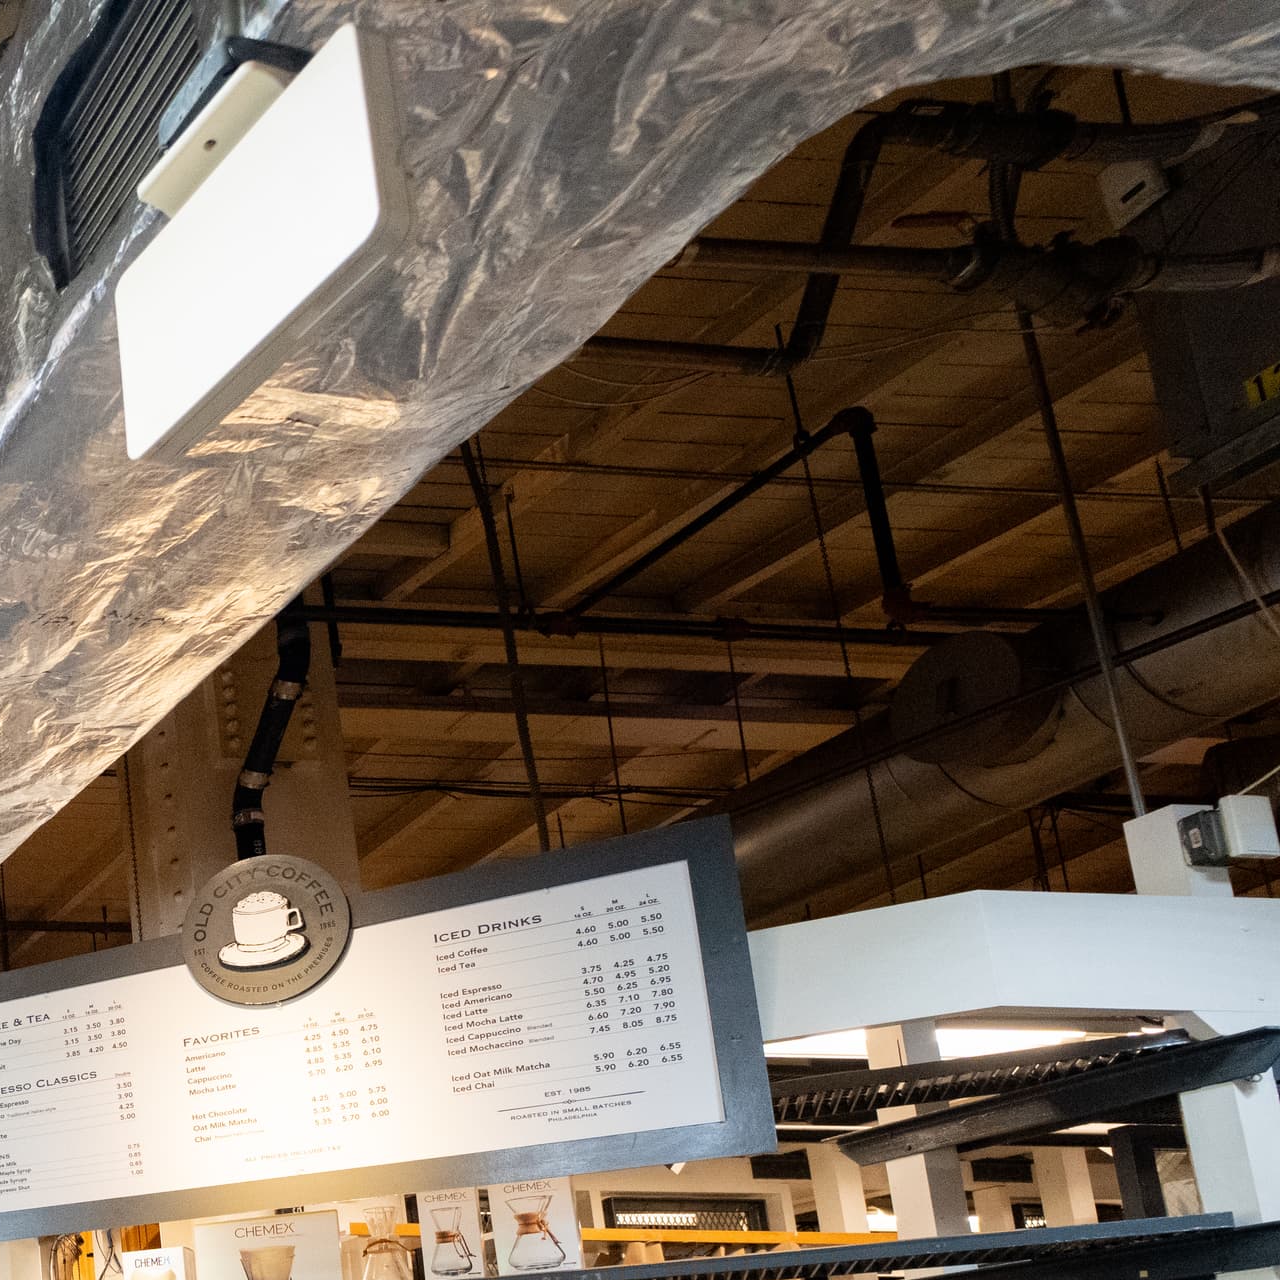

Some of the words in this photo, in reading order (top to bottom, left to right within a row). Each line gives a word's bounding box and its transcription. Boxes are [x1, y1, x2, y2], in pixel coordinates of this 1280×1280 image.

[194, 903, 214, 942] OLD
[213, 868, 256, 898] CITY
[267, 865, 334, 917] COFFEE
[434, 929, 472, 943] ICED
[478, 915, 542, 935] DRINKS
[576, 925, 596, 935] 4.60
[608, 919, 629, 929] 5.00
[640, 913, 662, 922] 5.50
[578, 938, 598, 948] 4.60
[610, 932, 631, 942] 5.00
[642, 926, 664, 935] 5.50
[436, 952, 455, 961] Iced
[458, 946, 488, 957] Coffee
[201, 962, 225, 985] COFFEE
[227, 983, 268, 992] ROASTED
[286, 974, 303, 984] THE
[303, 937, 333, 974] PREMISES
[438, 964, 456, 974] Iced
[459, 961, 476, 969] Tea
[581, 964, 602, 974] 3.75
[614, 959, 634, 968] 4.25
[647, 953, 668, 962] 4.75
[440, 990, 459, 999] Iced
[462, 982, 502, 996] Espresso
[441, 1000, 462, 1010] Iced
[464, 992, 513, 1006] Americano
[13, 1018, 22, 1026] &
[26, 1014, 50, 1024] TEA
[443, 1011, 462, 1020] Iced
[464, 1007, 488, 1017] Latte
[444, 1022, 464, 1032] Iced
[466, 1018, 497, 1029] Mocha
[499, 1013, 523, 1023] Latte
[590, 1024, 610, 1034] 7.45
[622, 1019, 644, 1028] 8.05
[655, 1014, 677, 1024] 8.75
[8, 1038, 21, 1047] Day
[183, 1027, 260, 1047] FAVORITES
[446, 1035, 465, 1044] Iced
[468, 1026, 521, 1042] Cappuccino
[448, 1047, 467, 1056] Iced
[469, 1038, 524, 1053] Mochaccino
[185, 1051, 226, 1062] Americano
[187, 1073, 232, 1086] Cappuccino
[452, 1072, 471, 1081] Iced
[473, 1070, 491, 1078] Oat
[494, 1067, 513, 1076] Milk
[516, 1061, 550, 1072] Matcha
[36, 1071, 97, 1090] CLASSICS
[453, 1083, 472, 1093] Iced
[475, 1081, 495, 1090] Chai
[569, 1086, 591, 1095] 1985
[502, 1180, 552, 1194] CHEMEX
[423, 1191, 467, 1202] CHEMEX
[234, 1222, 296, 1239] CHEMEX
[134, 1256, 171, 1268] CHEMEX
